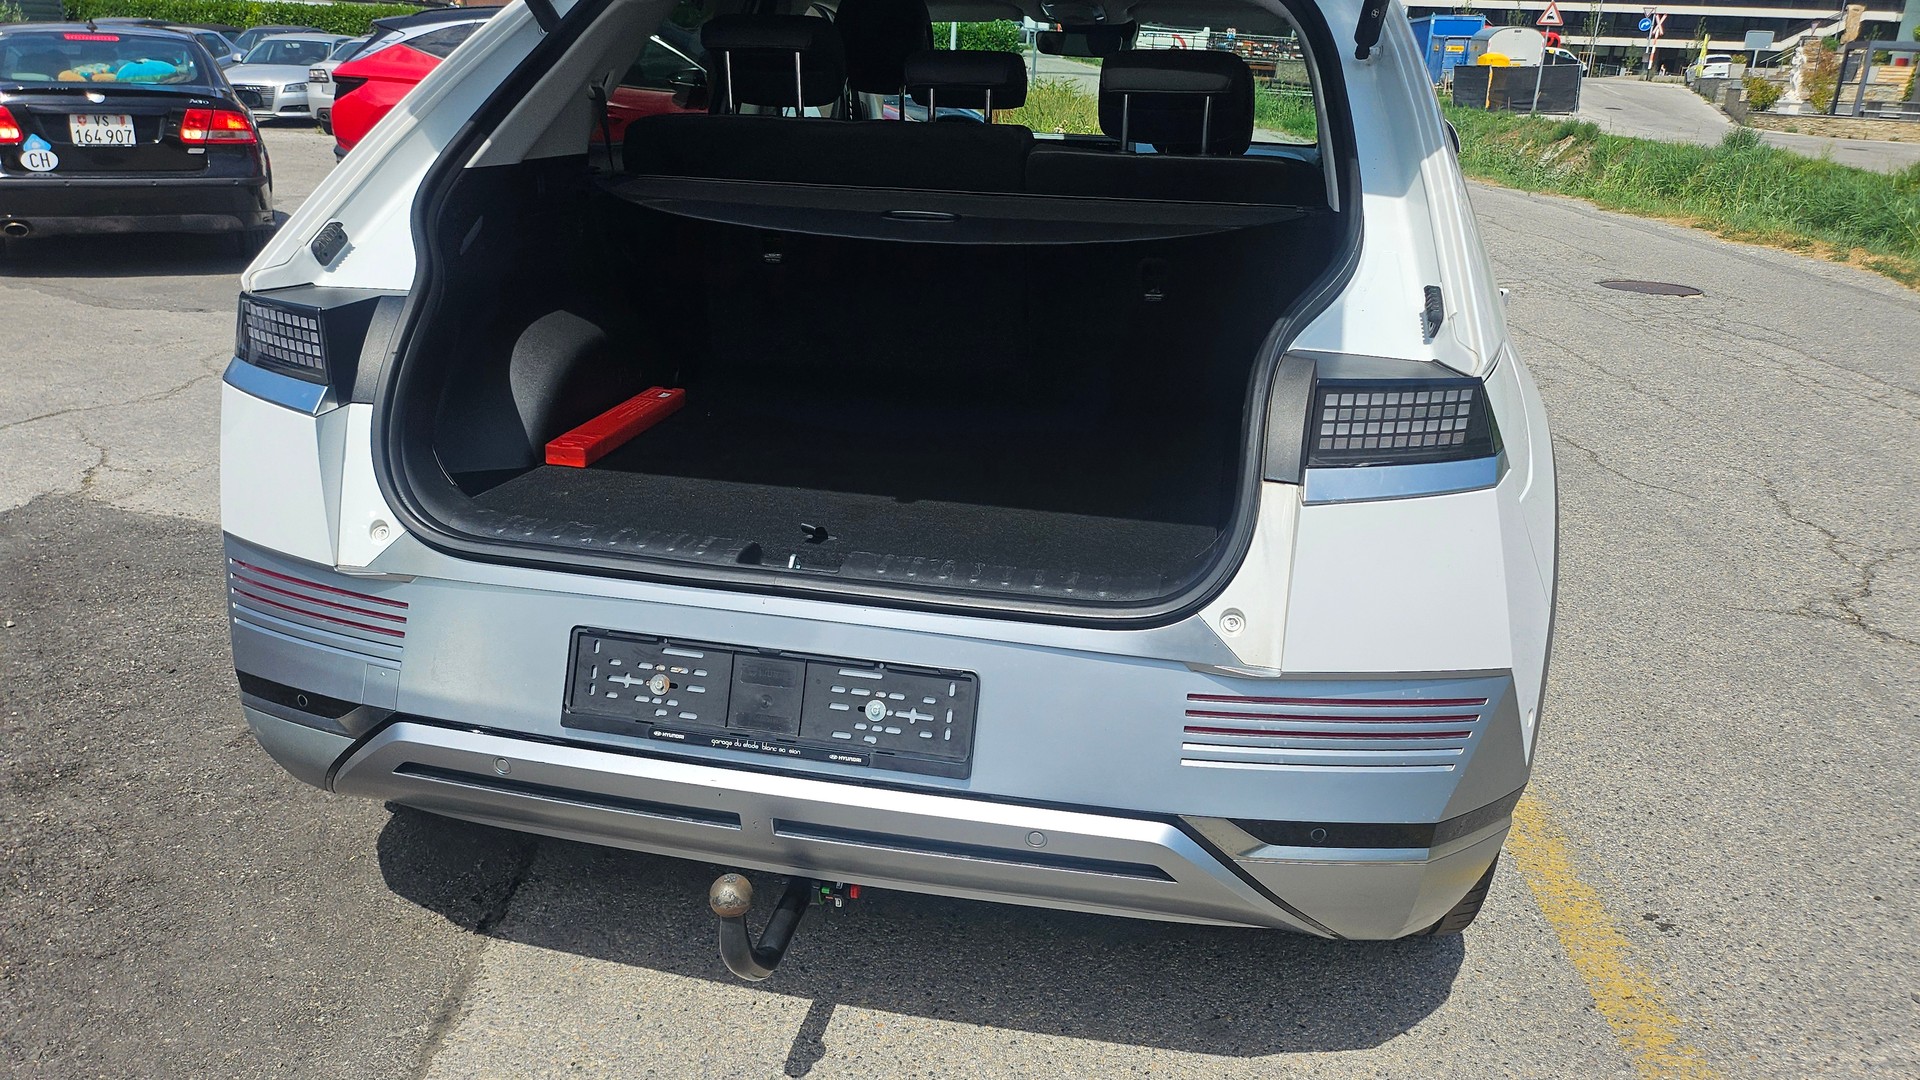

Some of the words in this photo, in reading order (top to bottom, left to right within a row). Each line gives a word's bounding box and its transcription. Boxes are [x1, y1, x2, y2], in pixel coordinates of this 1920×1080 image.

[94, 115, 110, 127] VS
[75, 129, 102, 143] 164
[106, 129, 132, 143] 907
[29, 153, 51, 168] CH
[662, 732, 685, 740] HYUNDAI
[711, 739, 733, 749] garage
[734, 738, 742, 747] du
[761, 742, 777, 752] blanc
[838, 755, 862, 763] HYUNDAI
